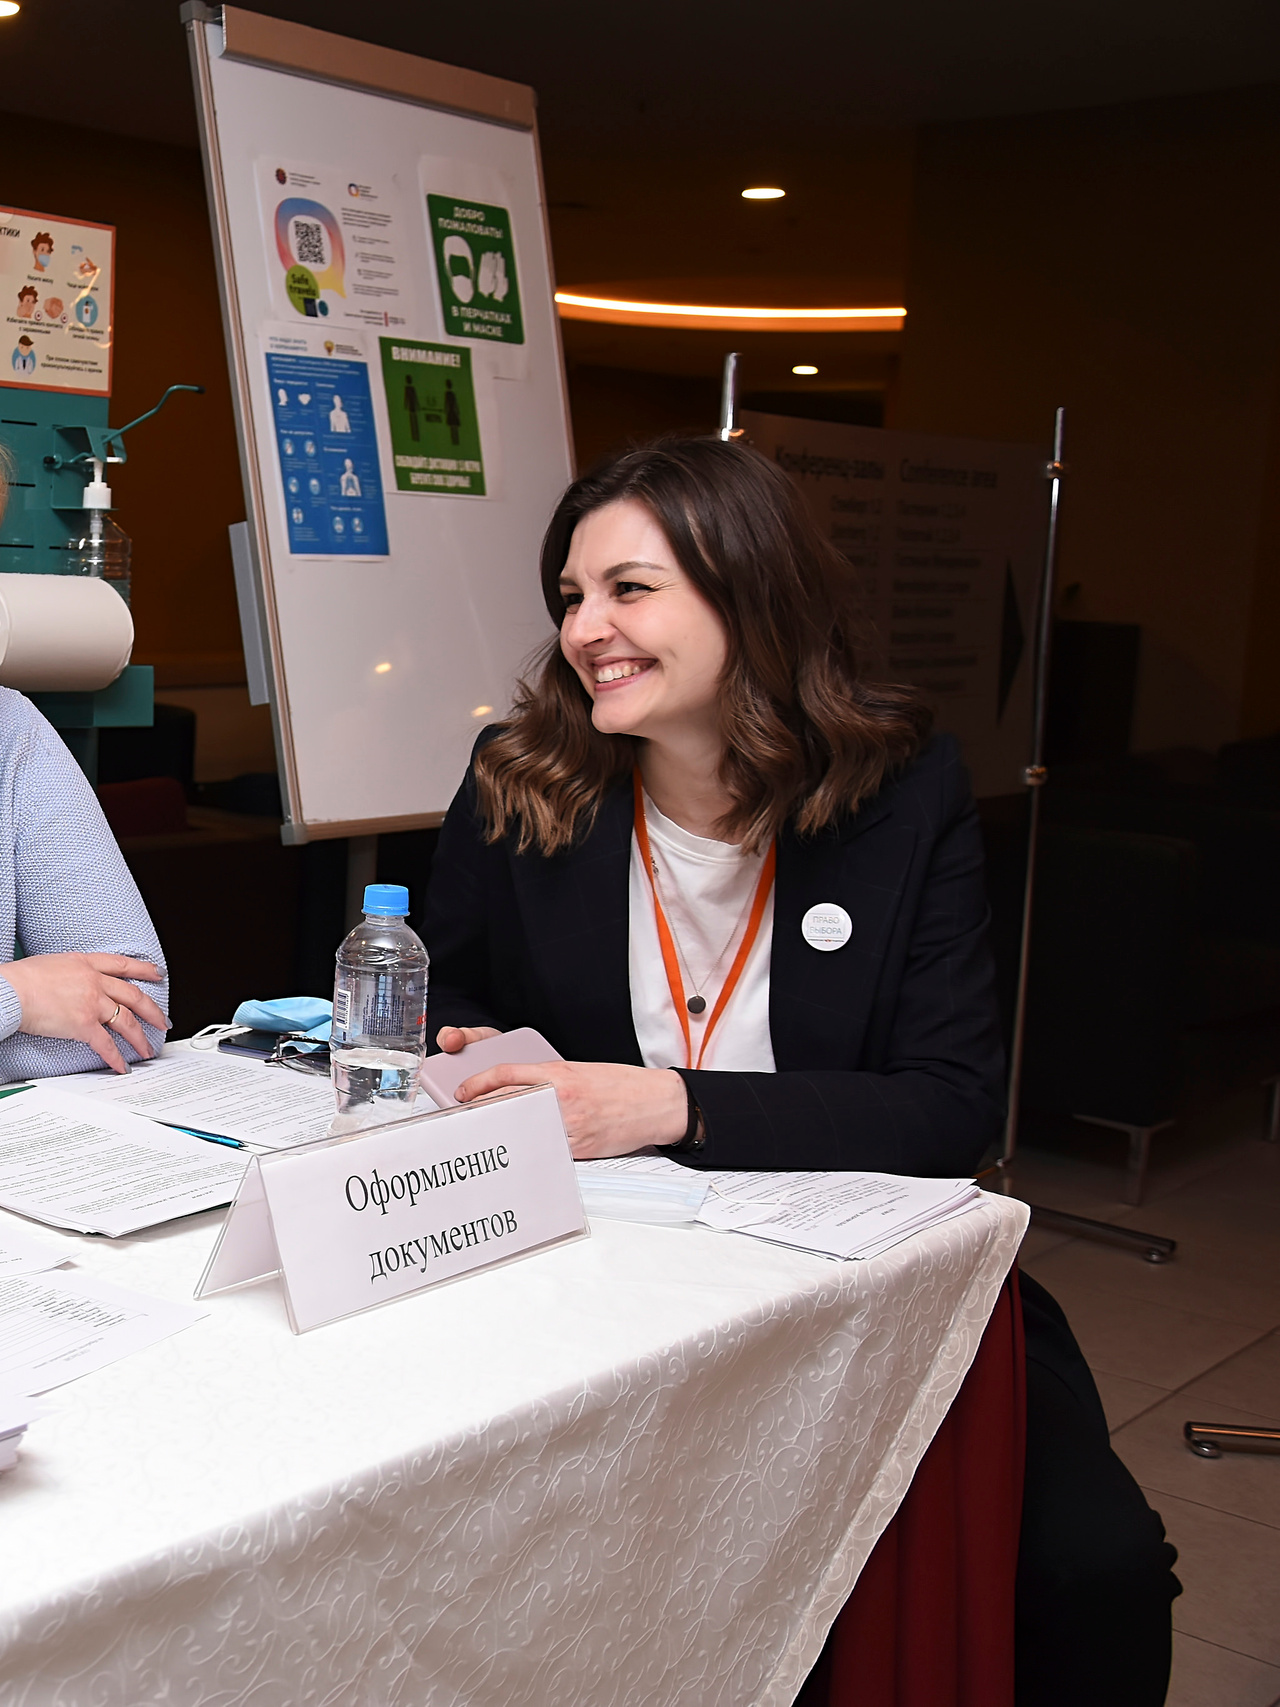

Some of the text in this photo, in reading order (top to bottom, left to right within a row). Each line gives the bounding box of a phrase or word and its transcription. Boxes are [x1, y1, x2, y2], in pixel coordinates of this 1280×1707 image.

[453, 206, 485, 221] ДОБРО
[291, 273, 309, 285] Safe
[290, 285, 317, 297] travels
[451, 305, 512, 324] В ПЕРЧАТКАХ
[472, 322, 503, 337] МАСКЕ
[391, 345, 461, 368] ВНИМАНИЕ!
[812, 915, 840, 925] ПРАВО
[344, 1143, 511, 1216] Оформление
[368, 1208, 519, 1285] документов
